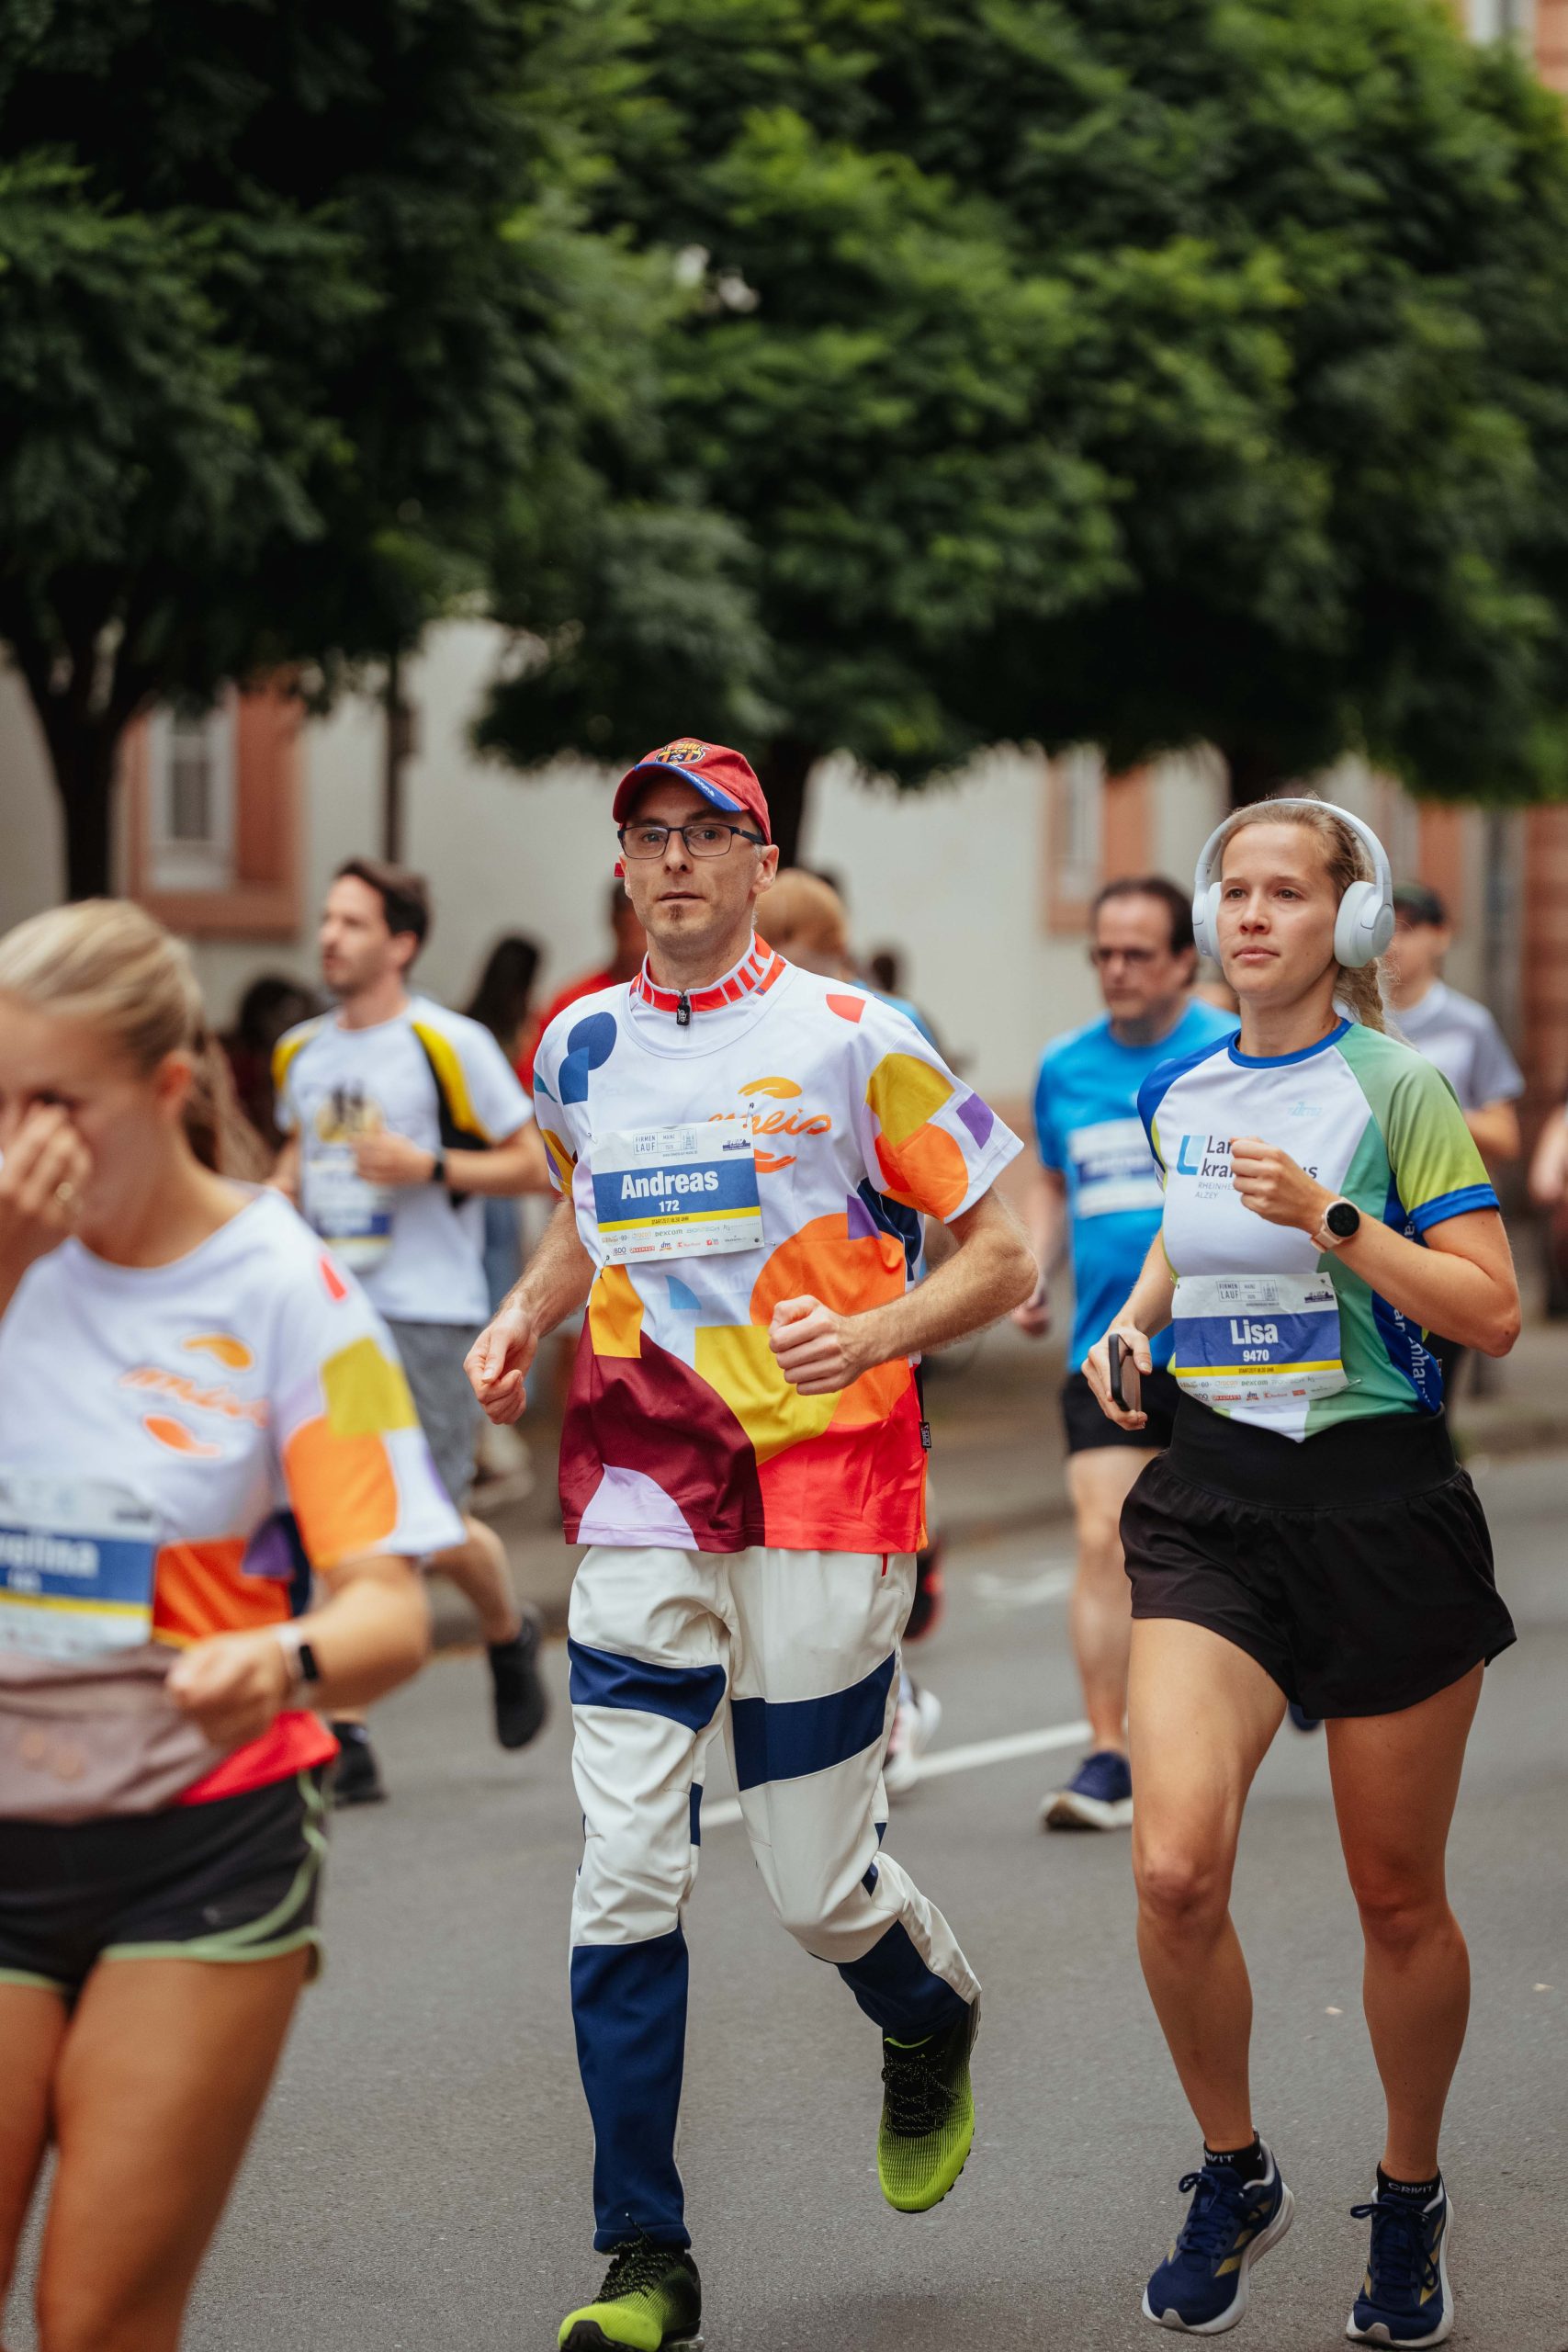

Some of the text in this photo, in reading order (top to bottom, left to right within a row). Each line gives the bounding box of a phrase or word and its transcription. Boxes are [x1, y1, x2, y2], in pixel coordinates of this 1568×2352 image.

[636, 1142, 656, 1153] LAUF
[621, 1167, 719, 1201] Andreas
[1195, 1191, 1219, 1199] ALZEY
[658, 1199, 680, 1213] 172
[1220, 1290, 1239, 1300] LAUF
[1230, 1318, 1279, 1346] Lisa
[1242, 1349, 1269, 1363] 9470
[1388, 2181, 1434, 2194] CRIVIT
